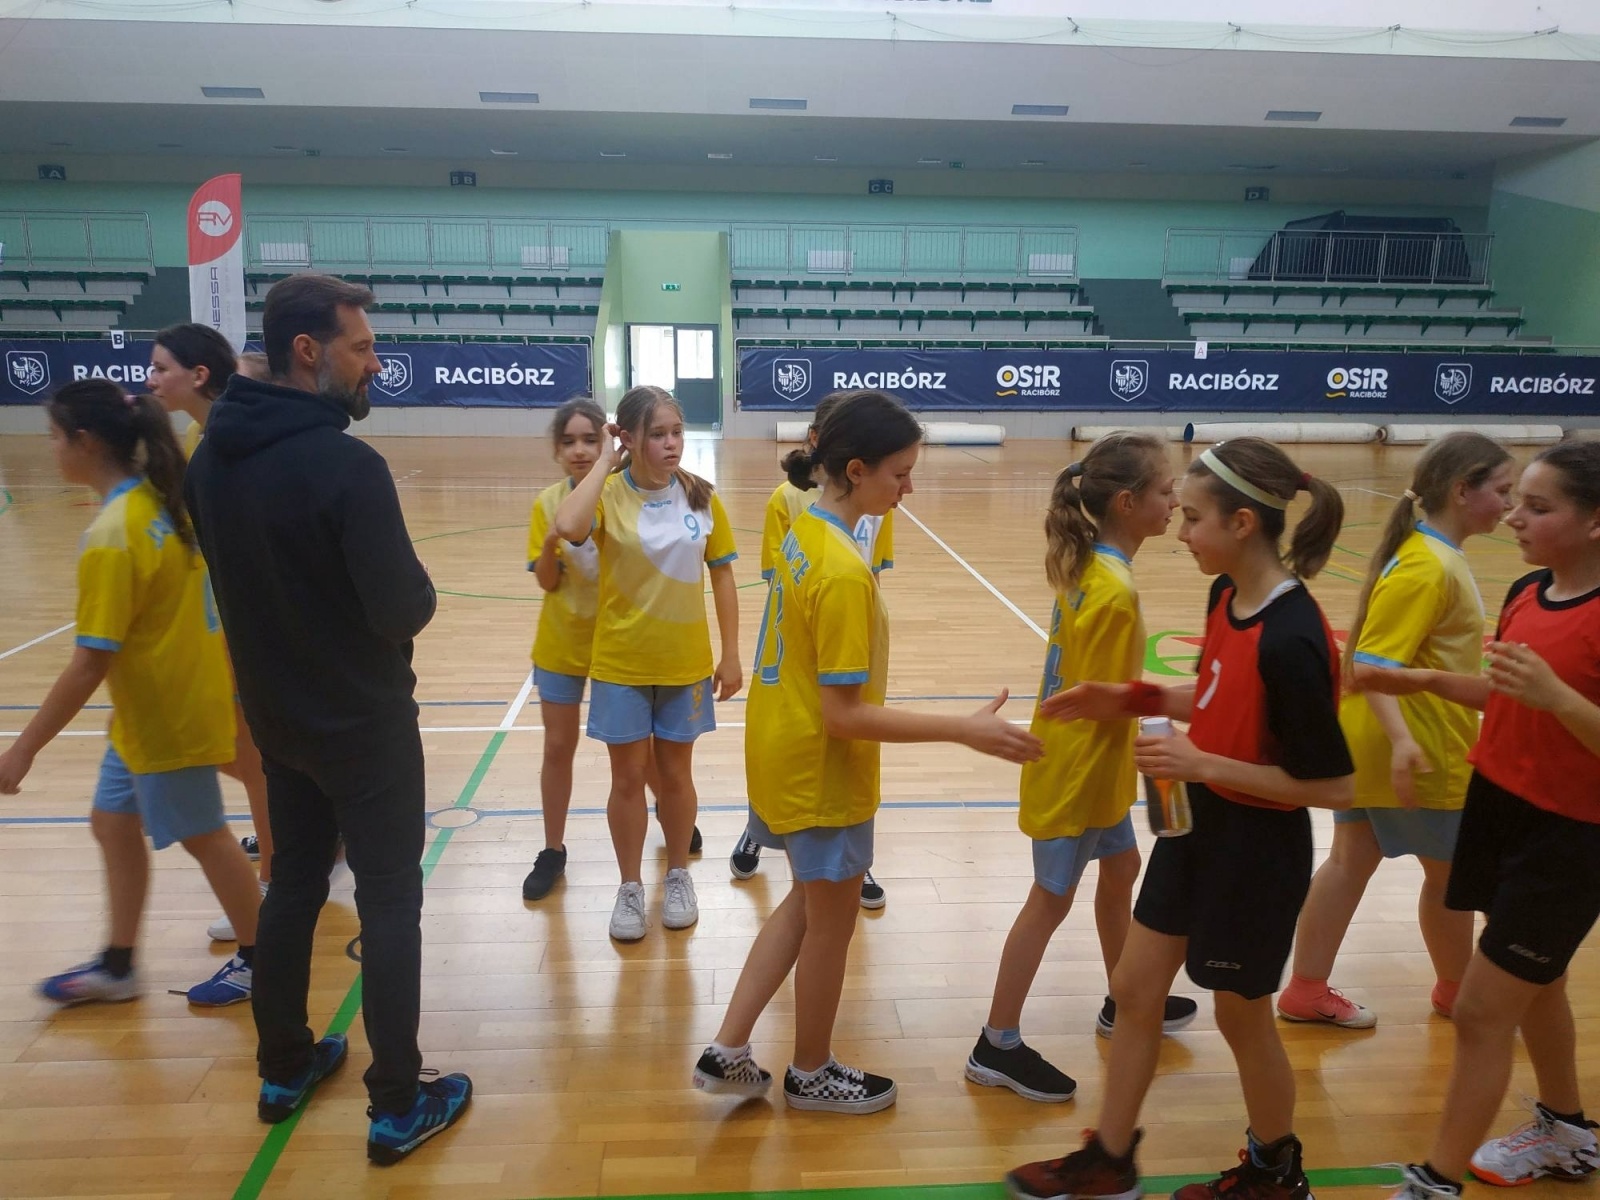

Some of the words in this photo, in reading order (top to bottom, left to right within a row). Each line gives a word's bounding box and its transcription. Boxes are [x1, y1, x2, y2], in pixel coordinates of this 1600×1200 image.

[113, 333, 124, 345] B
[1197, 346, 1205, 356] A
[435, 362, 555, 386] RACIBÓRZ
[833, 366, 946, 389] RACIBÓRZ
[996, 364, 1061, 388] OSiR
[1168, 368, 1279, 391] RACIBÓRZ
[1326, 367, 1388, 390] OSiR
[1490, 373, 1596, 395] RACIBÓRZ
[1021, 388, 1060, 396] RACIBÓRZ
[1350, 390, 1387, 398] RACIBÓRZ
[684, 513, 700, 541] 9
[857, 519, 870, 548] 4
